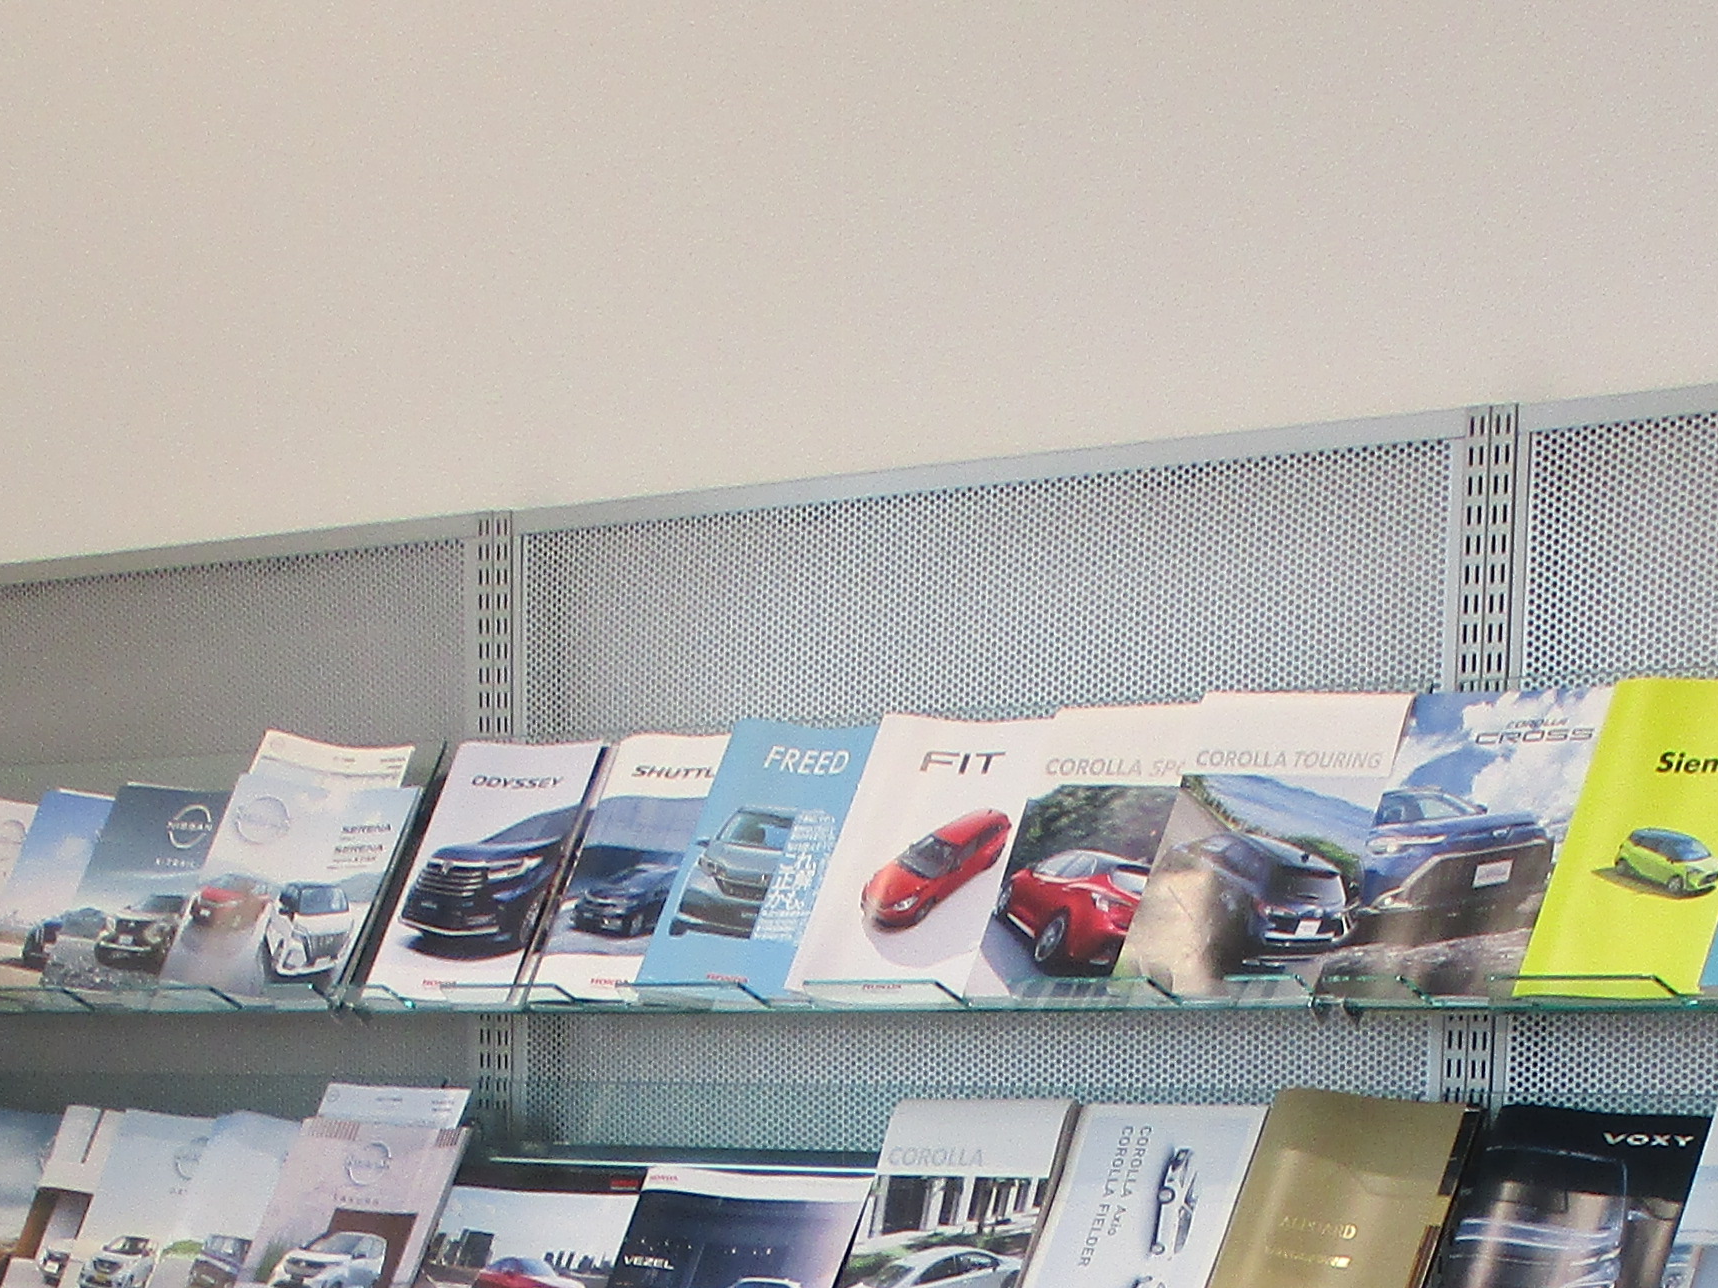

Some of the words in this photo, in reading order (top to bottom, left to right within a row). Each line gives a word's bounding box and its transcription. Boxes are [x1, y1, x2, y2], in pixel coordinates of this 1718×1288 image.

[1475, 728, 1596, 746] CROSS
[763, 744, 850, 775] FREED
[917, 751, 1006, 775] FIT
[1044, 757, 1142, 777] COROLLA
[1196, 750, 1287, 768] COROLLA
[1294, 752, 1381, 770] TOURING
[471, 774, 564, 790] ODYSSEY
[1603, 1132, 1695, 1147] VOXY
[887, 1146, 984, 1168] COROLLA
[1102, 1126, 1133, 1199] COROLLA
[1119, 1126, 1151, 1199] COROLLA
[1077, 1202, 1111, 1268] FIELDER
[624, 1255, 674, 1271] VEZEL
